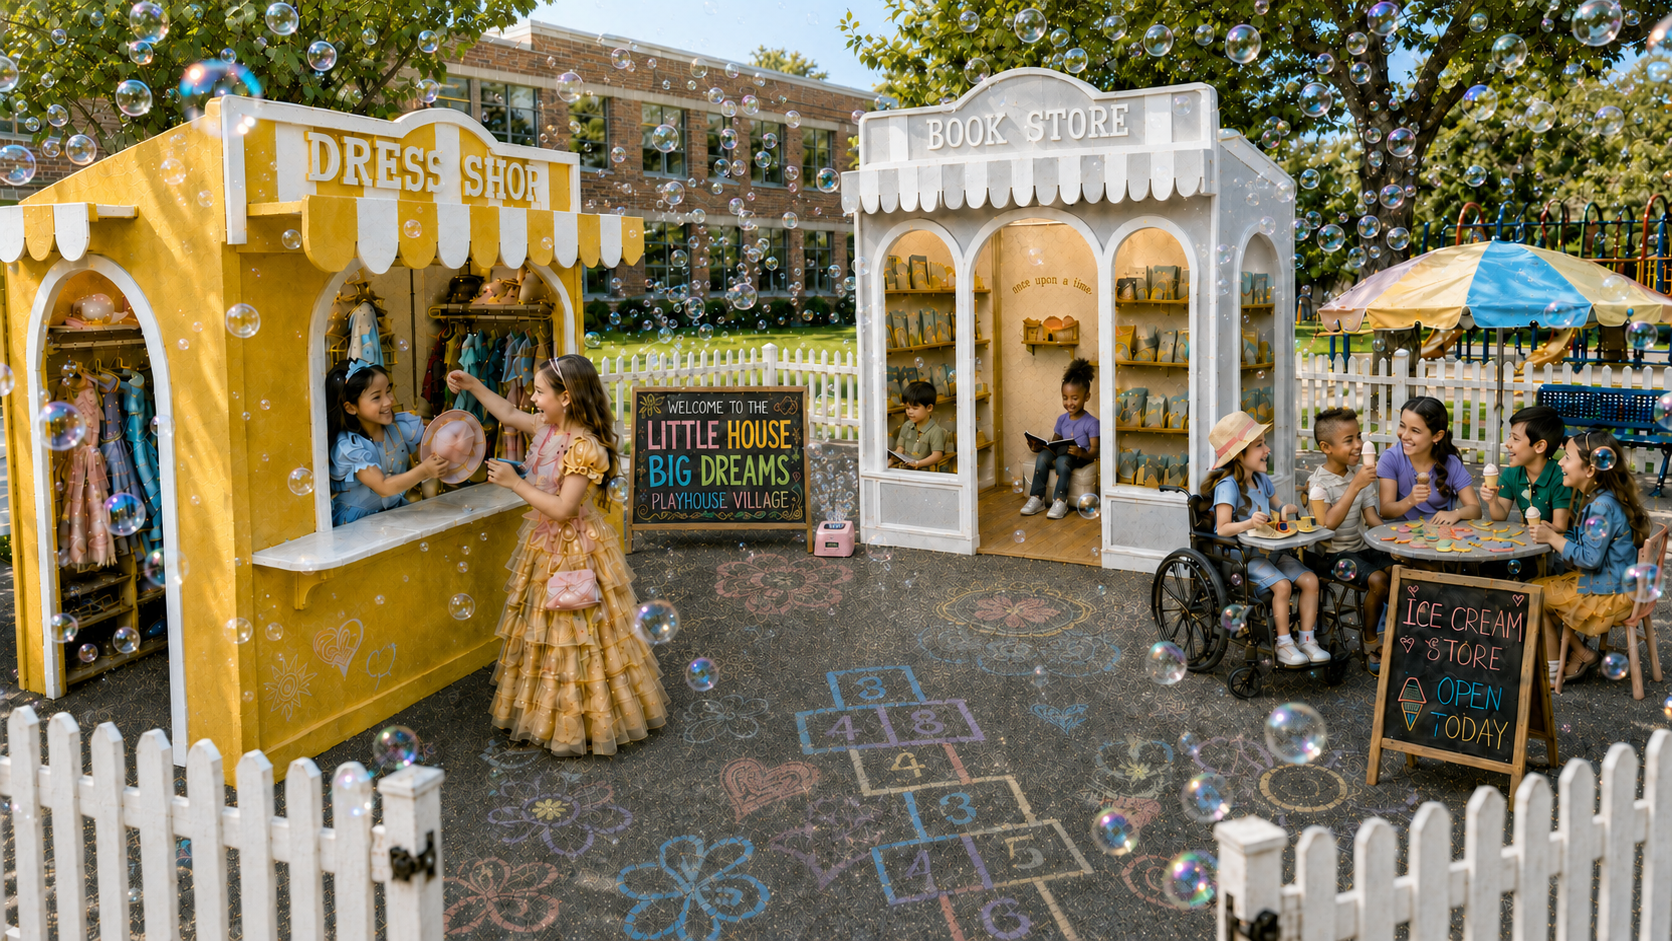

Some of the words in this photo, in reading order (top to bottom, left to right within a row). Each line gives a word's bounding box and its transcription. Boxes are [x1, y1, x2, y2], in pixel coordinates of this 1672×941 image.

[926, 112, 1008, 150] BOOK
[1026, 103, 1129, 142] STORE
[305, 131, 446, 194] DRESS
[461, 154, 541, 202] SHOP
[1012, 279, 1031, 294] once
[1035, 276, 1057, 287] upon
[1062, 278, 1069, 286] a
[667, 400, 724, 415] WELCOME
[729, 400, 744, 414] TO
[748, 400, 769, 414] THE
[647, 420, 720, 450] LITTLE
[727, 419, 792, 450] HOUSE
[648, 454, 692, 488] BIG
[700, 454, 791, 487] DREAMS
[651, 491, 728, 510] PLAYHOUSE
[732, 490, 789, 509] VILLAGE
[1402, 598, 1443, 629] ICE
[1450, 606, 1523, 643] CREAM
[1425, 637, 1503, 671] STORE
[856, 676, 886, 700] 3
[1437, 676, 1503, 711] OPEN
[825, 714, 862, 741] 4
[910, 709, 944, 735] 8
[1430, 711, 1509, 750] TODAY
[890, 752, 926, 778] 4
[939, 791, 977, 825] 3
[1004, 833, 1044, 870] 5
